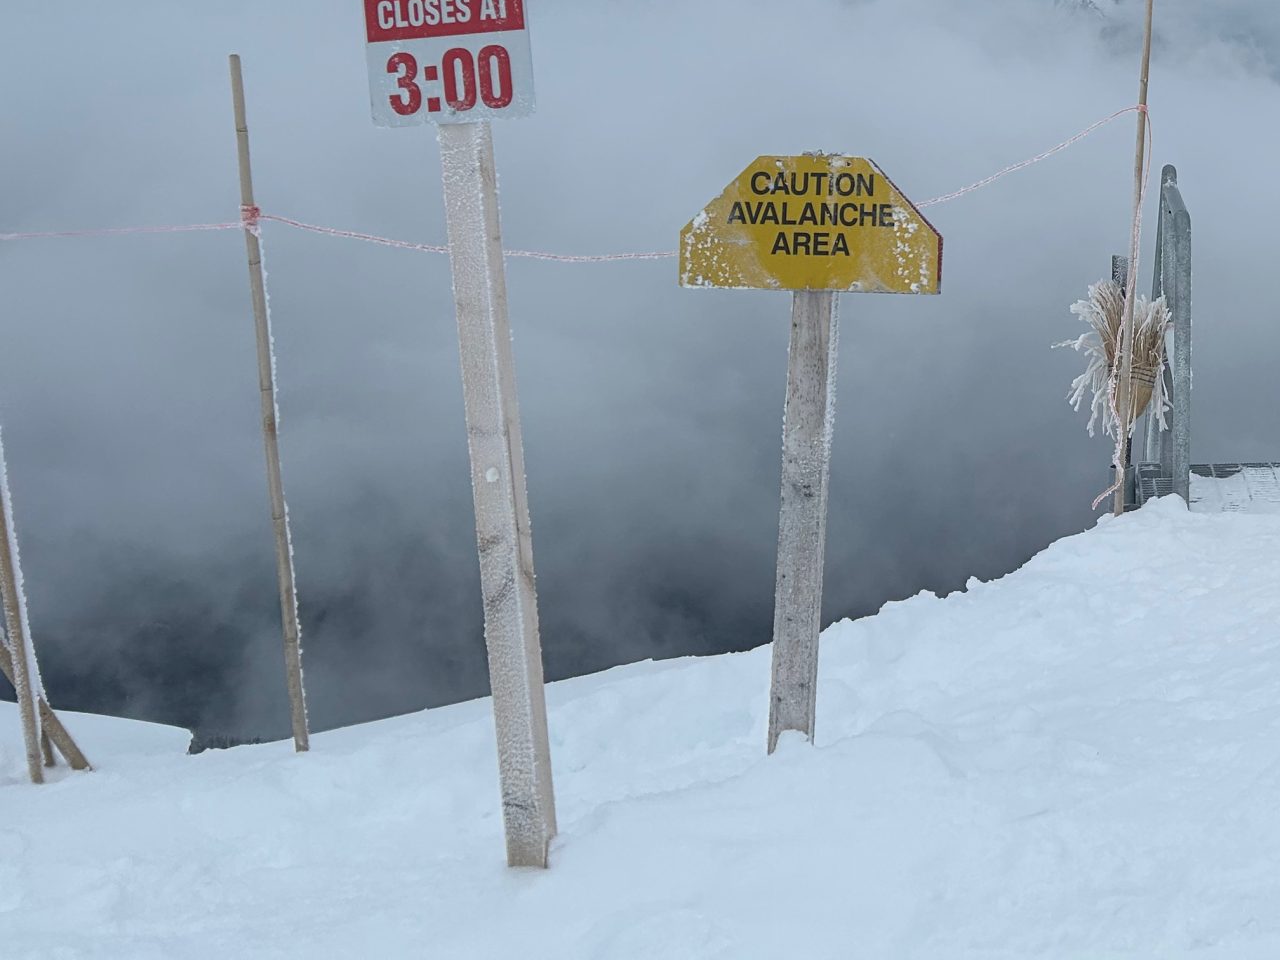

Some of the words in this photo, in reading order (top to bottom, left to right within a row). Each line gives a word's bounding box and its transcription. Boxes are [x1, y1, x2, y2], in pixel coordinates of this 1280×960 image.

[386, 45, 513, 116] 3:00
[751, 171, 875, 197] CAUTION
[727, 201, 896, 227] AVALANCHE
[770, 231, 850, 257] AREA
